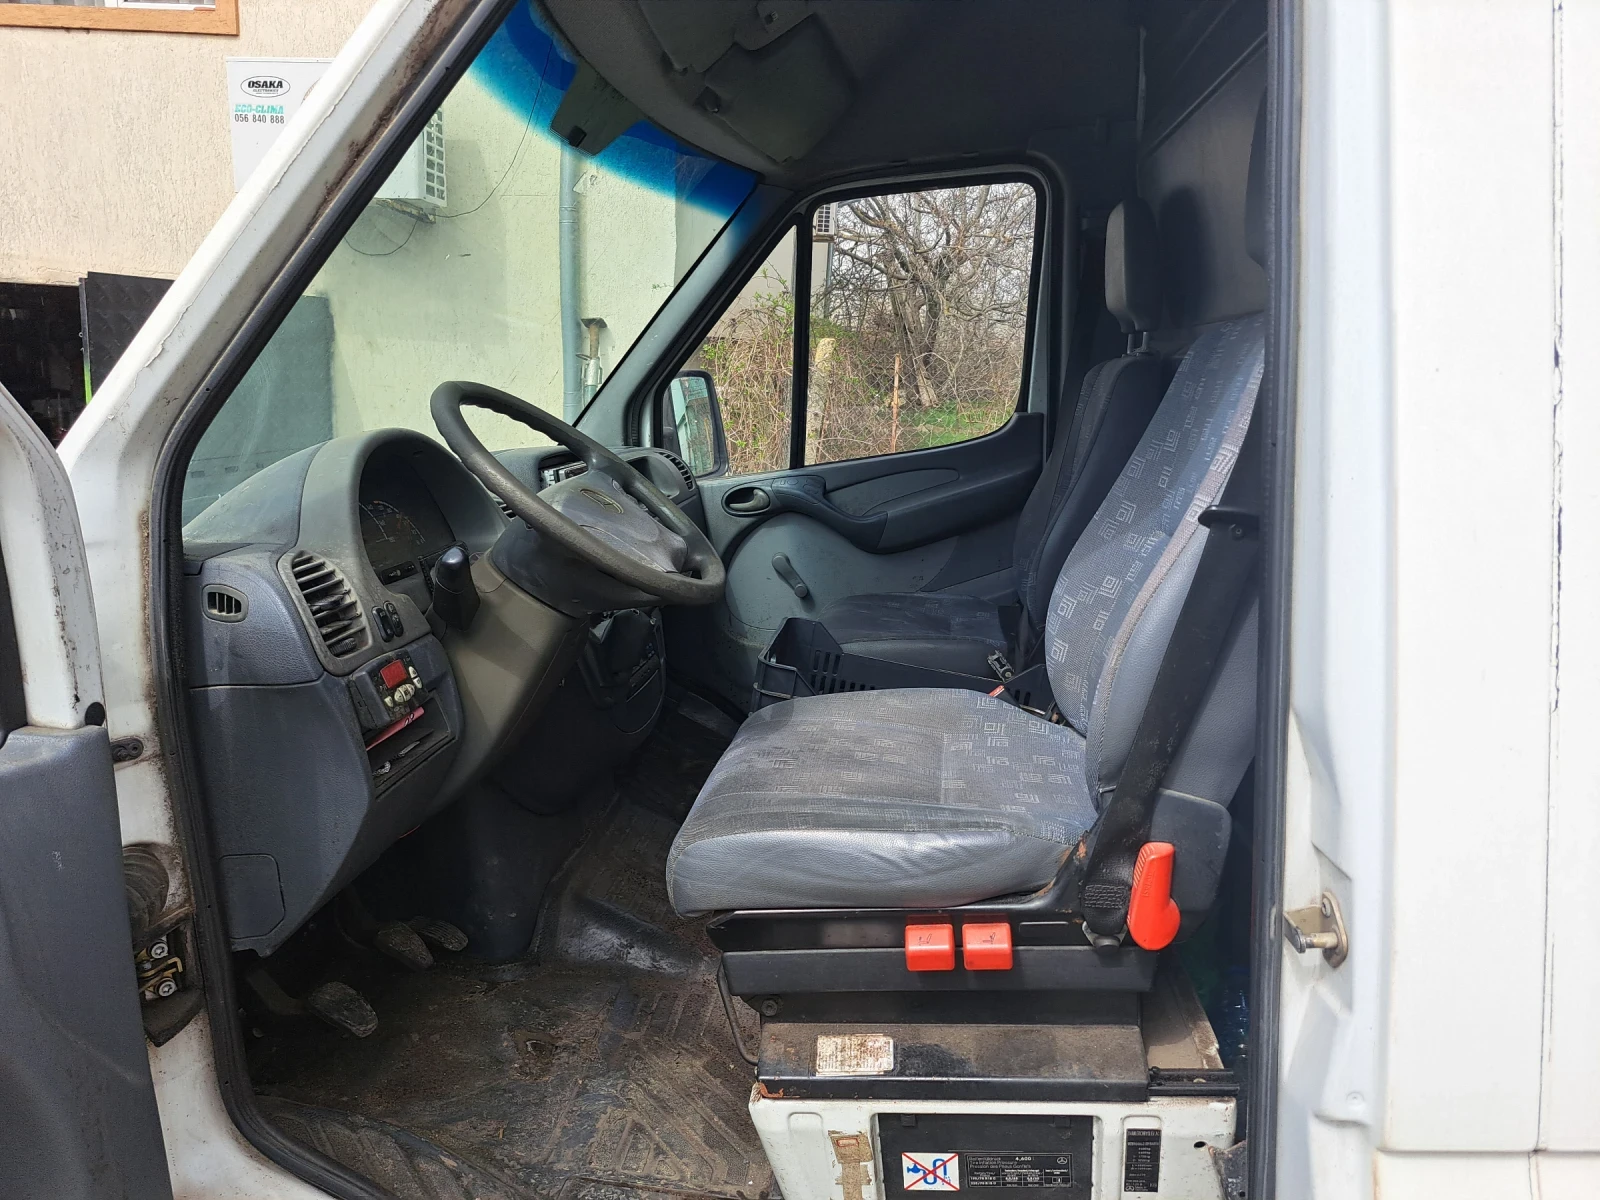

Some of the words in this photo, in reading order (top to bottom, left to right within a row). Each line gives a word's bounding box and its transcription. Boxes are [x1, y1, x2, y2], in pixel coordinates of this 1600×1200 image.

[248, 80, 284, 89] OSAKA
[234, 104, 284, 114] ECO-CLIMA
[234, 113, 249, 123] 056
[252, 114, 267, 124] 840
[270, 115, 285, 124] 888
